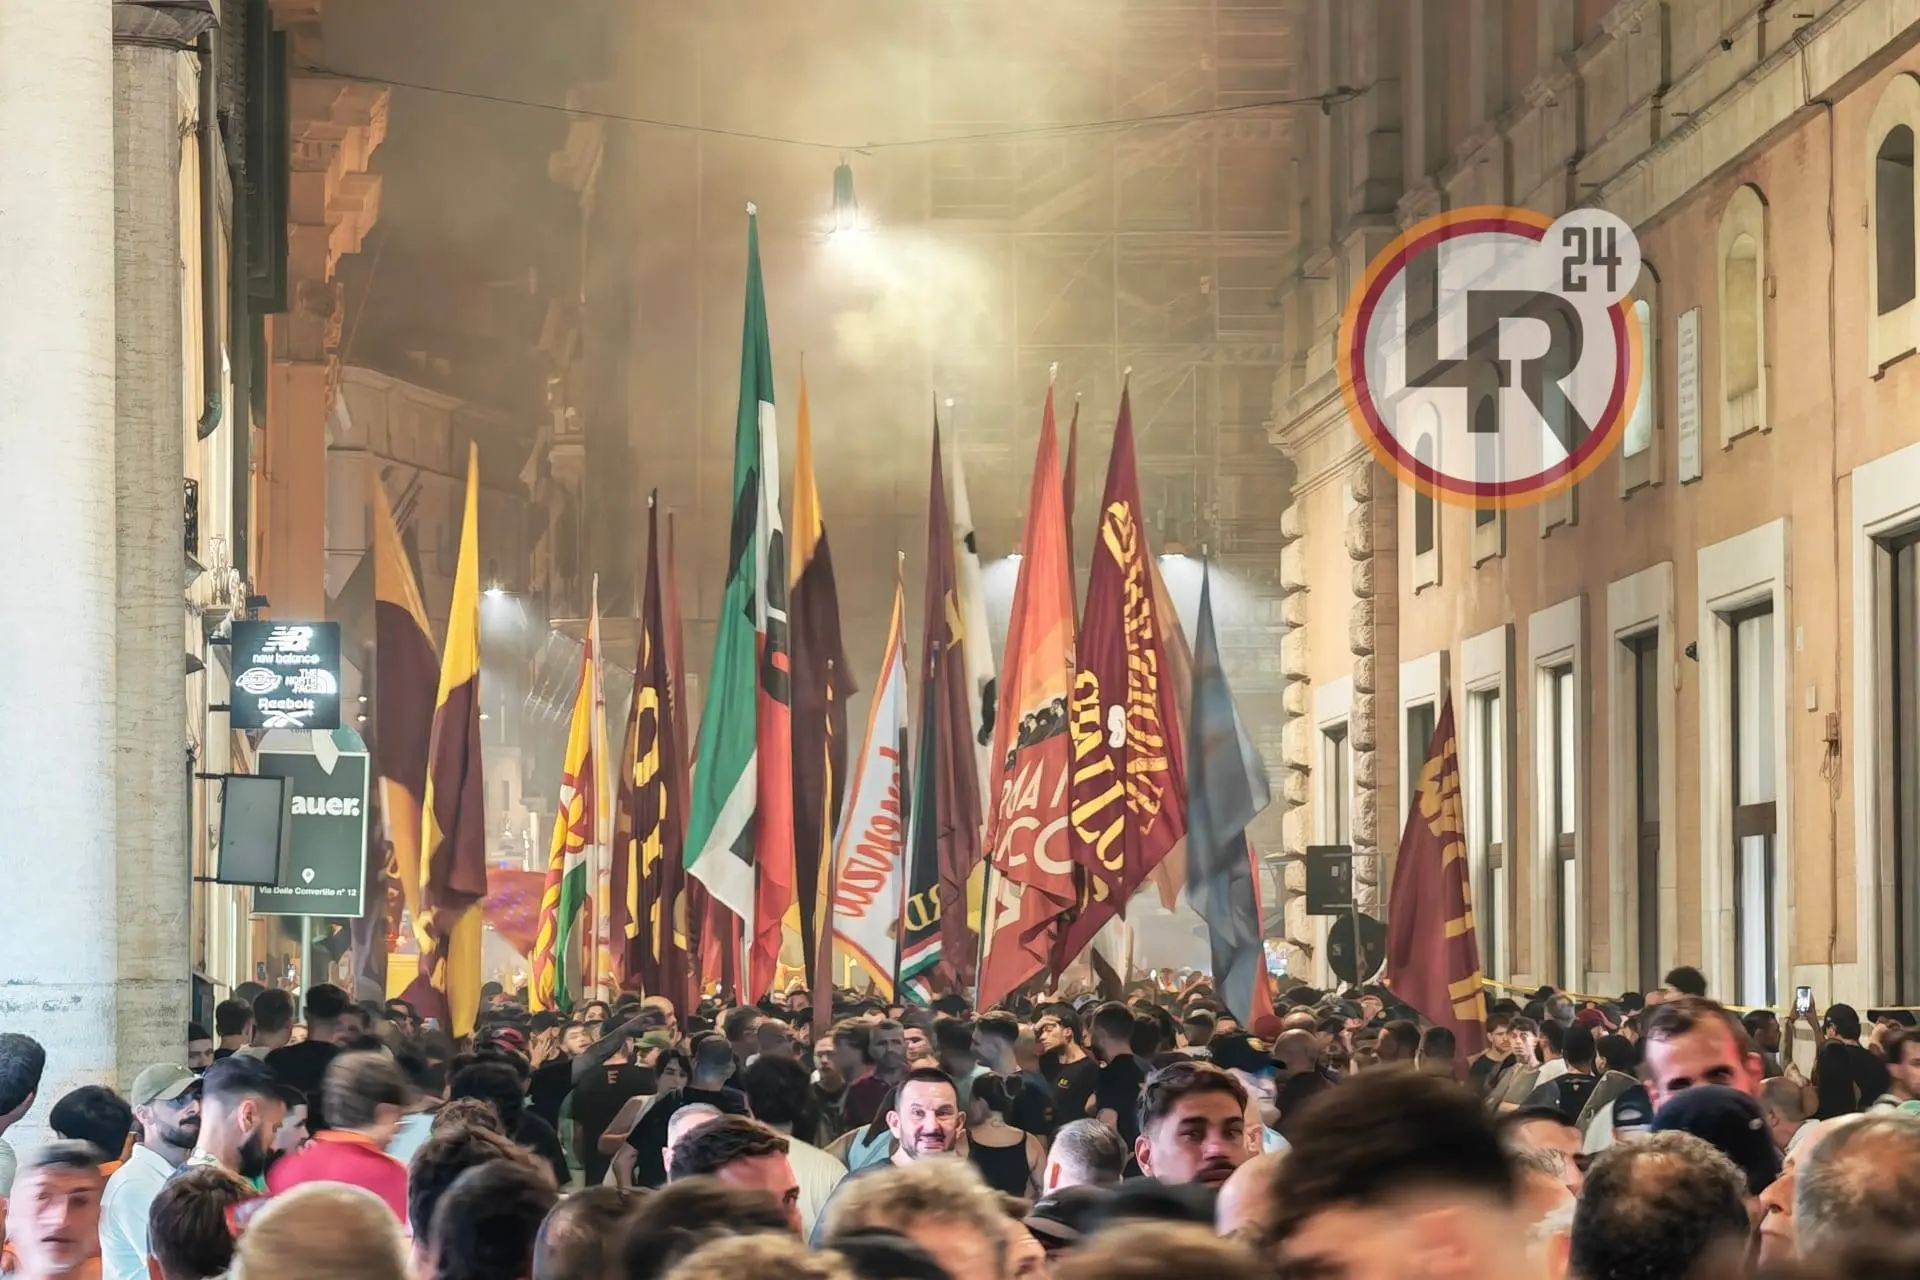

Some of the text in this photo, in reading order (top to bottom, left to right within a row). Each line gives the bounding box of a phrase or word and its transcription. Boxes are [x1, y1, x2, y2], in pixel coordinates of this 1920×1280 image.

[252, 652, 320, 665] new balance
[258, 698, 315, 710] Reebok
[259, 886, 272, 894] Via
[347, 888, 357, 896] 12
